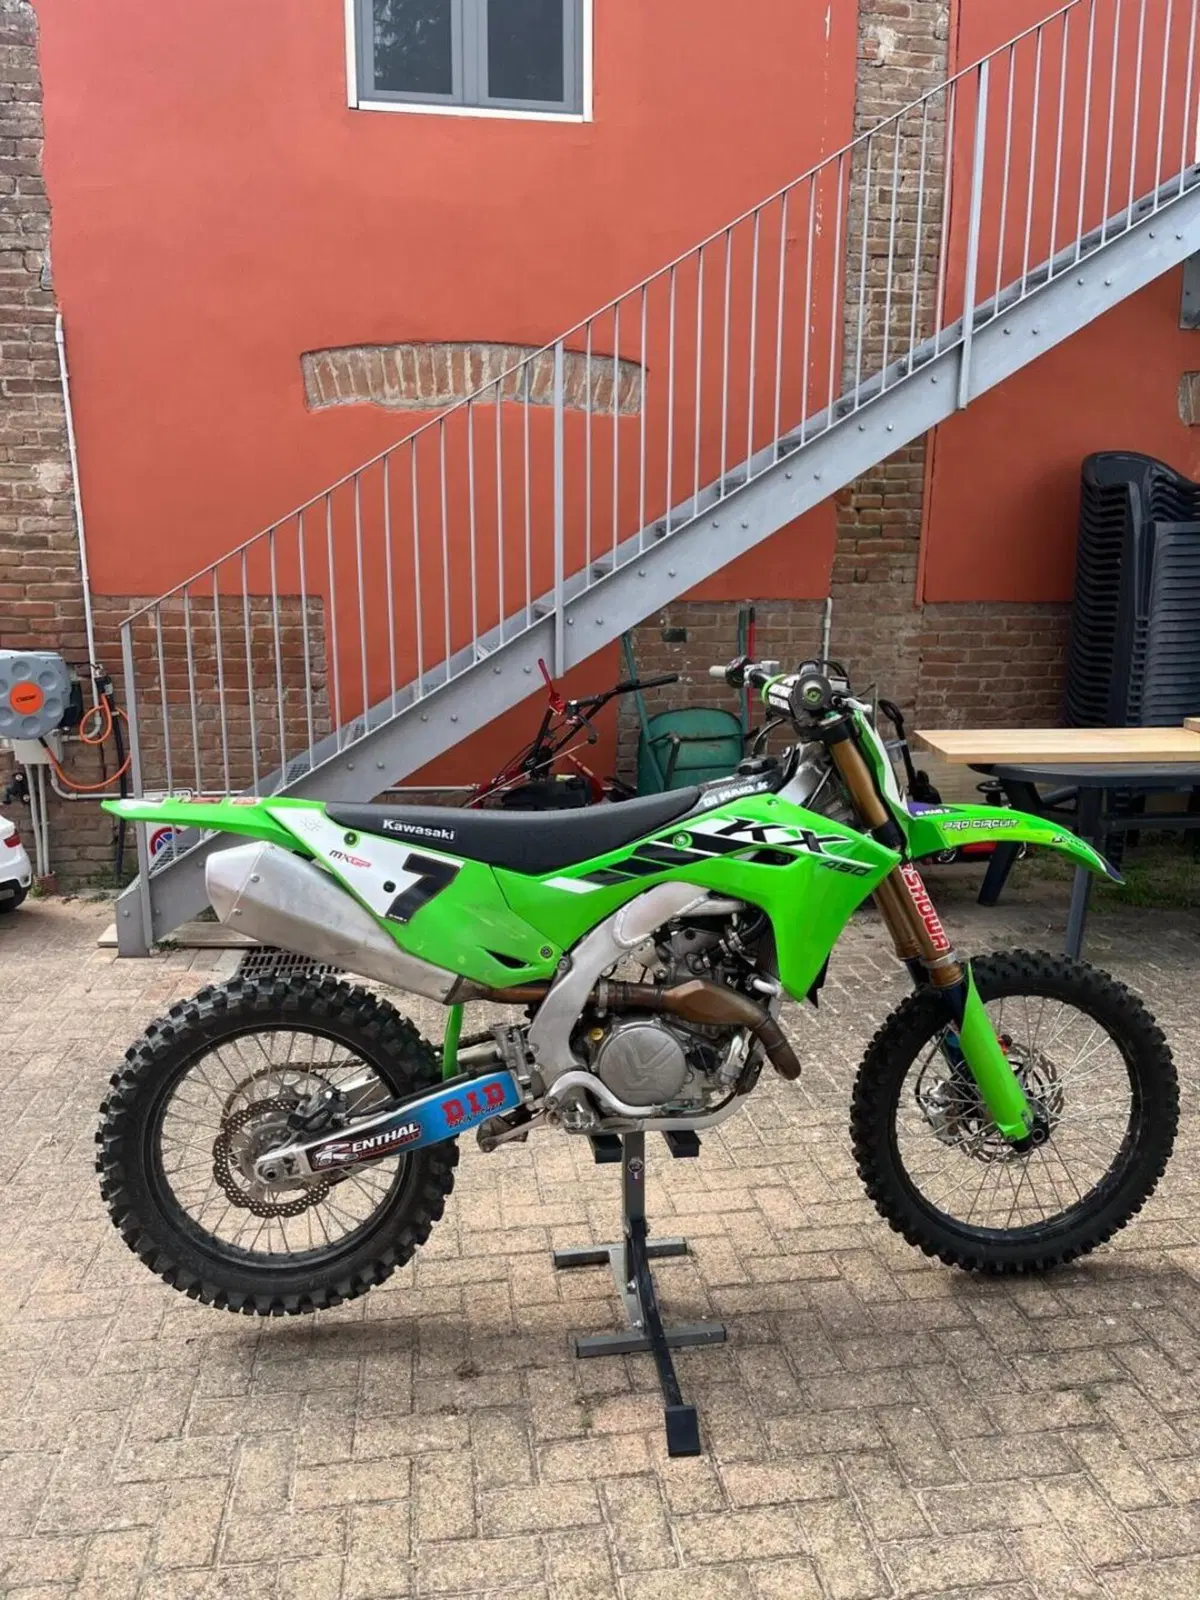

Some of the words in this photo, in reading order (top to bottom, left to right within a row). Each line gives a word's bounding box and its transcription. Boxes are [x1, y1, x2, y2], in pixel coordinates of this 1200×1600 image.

[382, 819, 456, 840] Kawasaki
[714, 817, 850, 854] KX
[942, 819, 969, 830] PRO
[971, 818, 1019, 830] CIRCUIT
[819, 859, 875, 877] 450
[385, 852, 461, 924] 7
[902, 869, 950, 951] SHOWA
